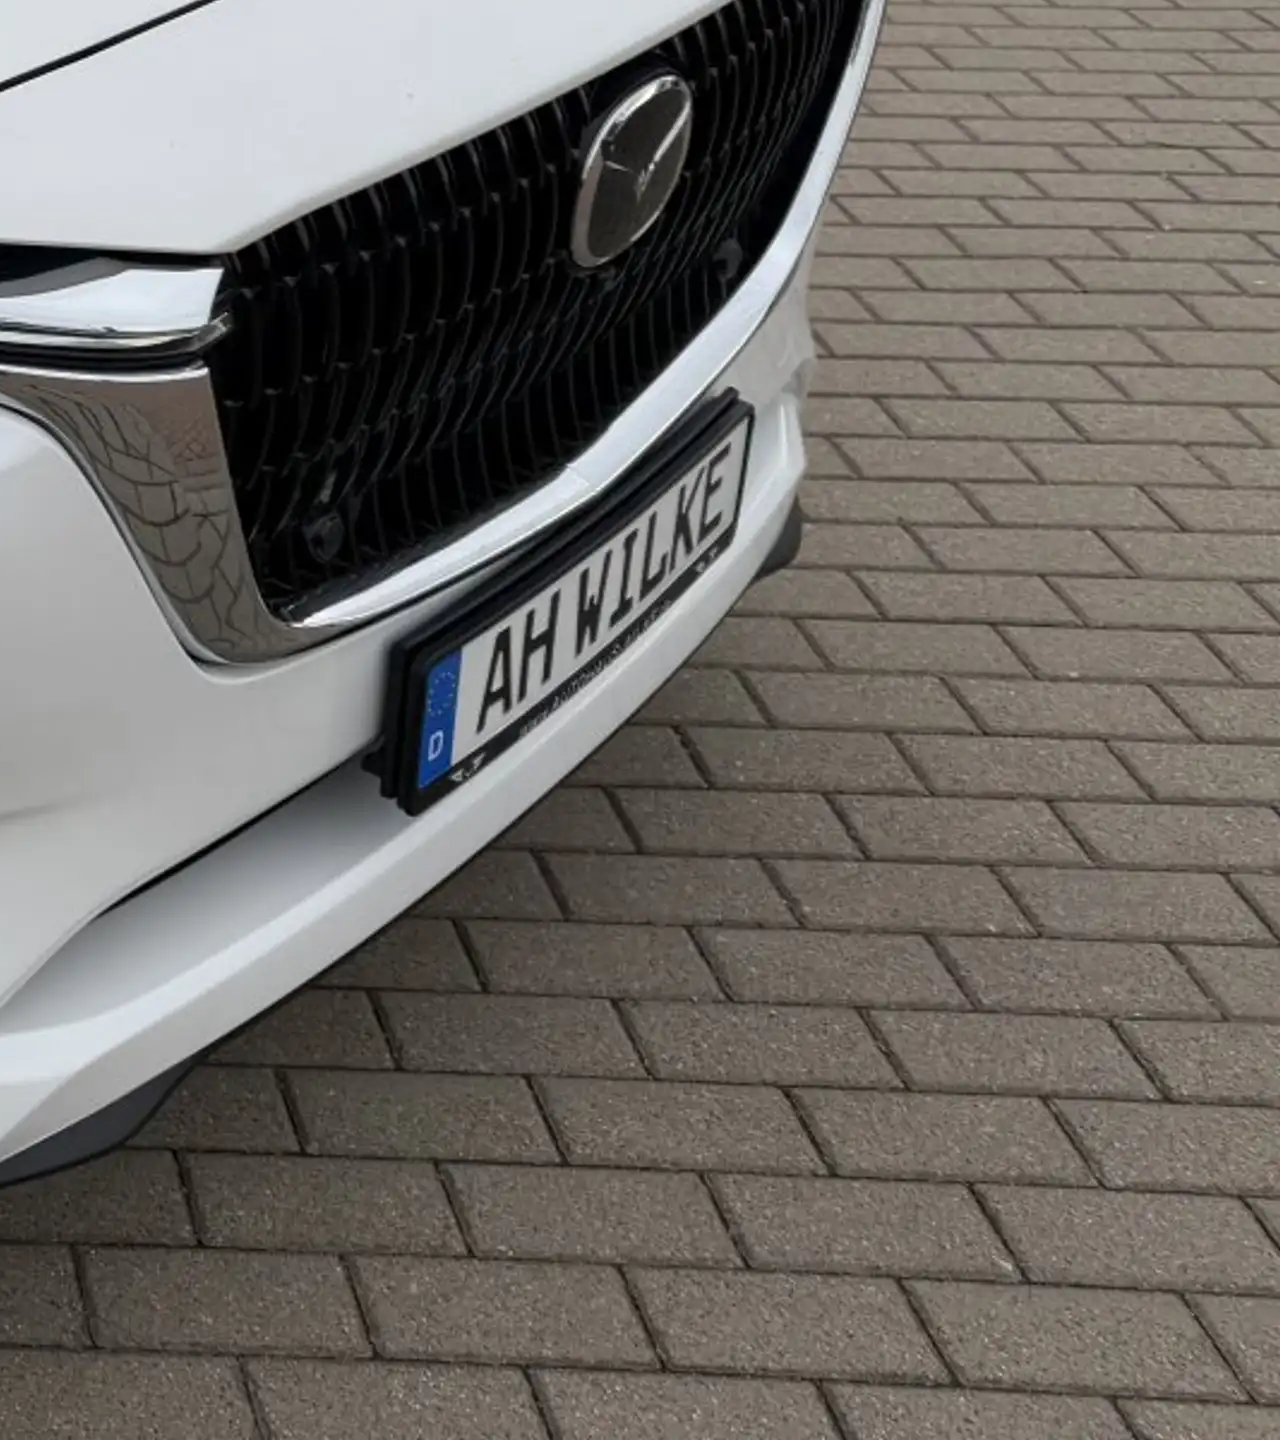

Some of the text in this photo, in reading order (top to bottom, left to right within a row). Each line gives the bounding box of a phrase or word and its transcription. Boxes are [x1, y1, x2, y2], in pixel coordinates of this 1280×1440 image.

[427, 730, 444, 761] D
[476, 588, 561, 735] AH
[573, 441, 731, 659] WILKE
